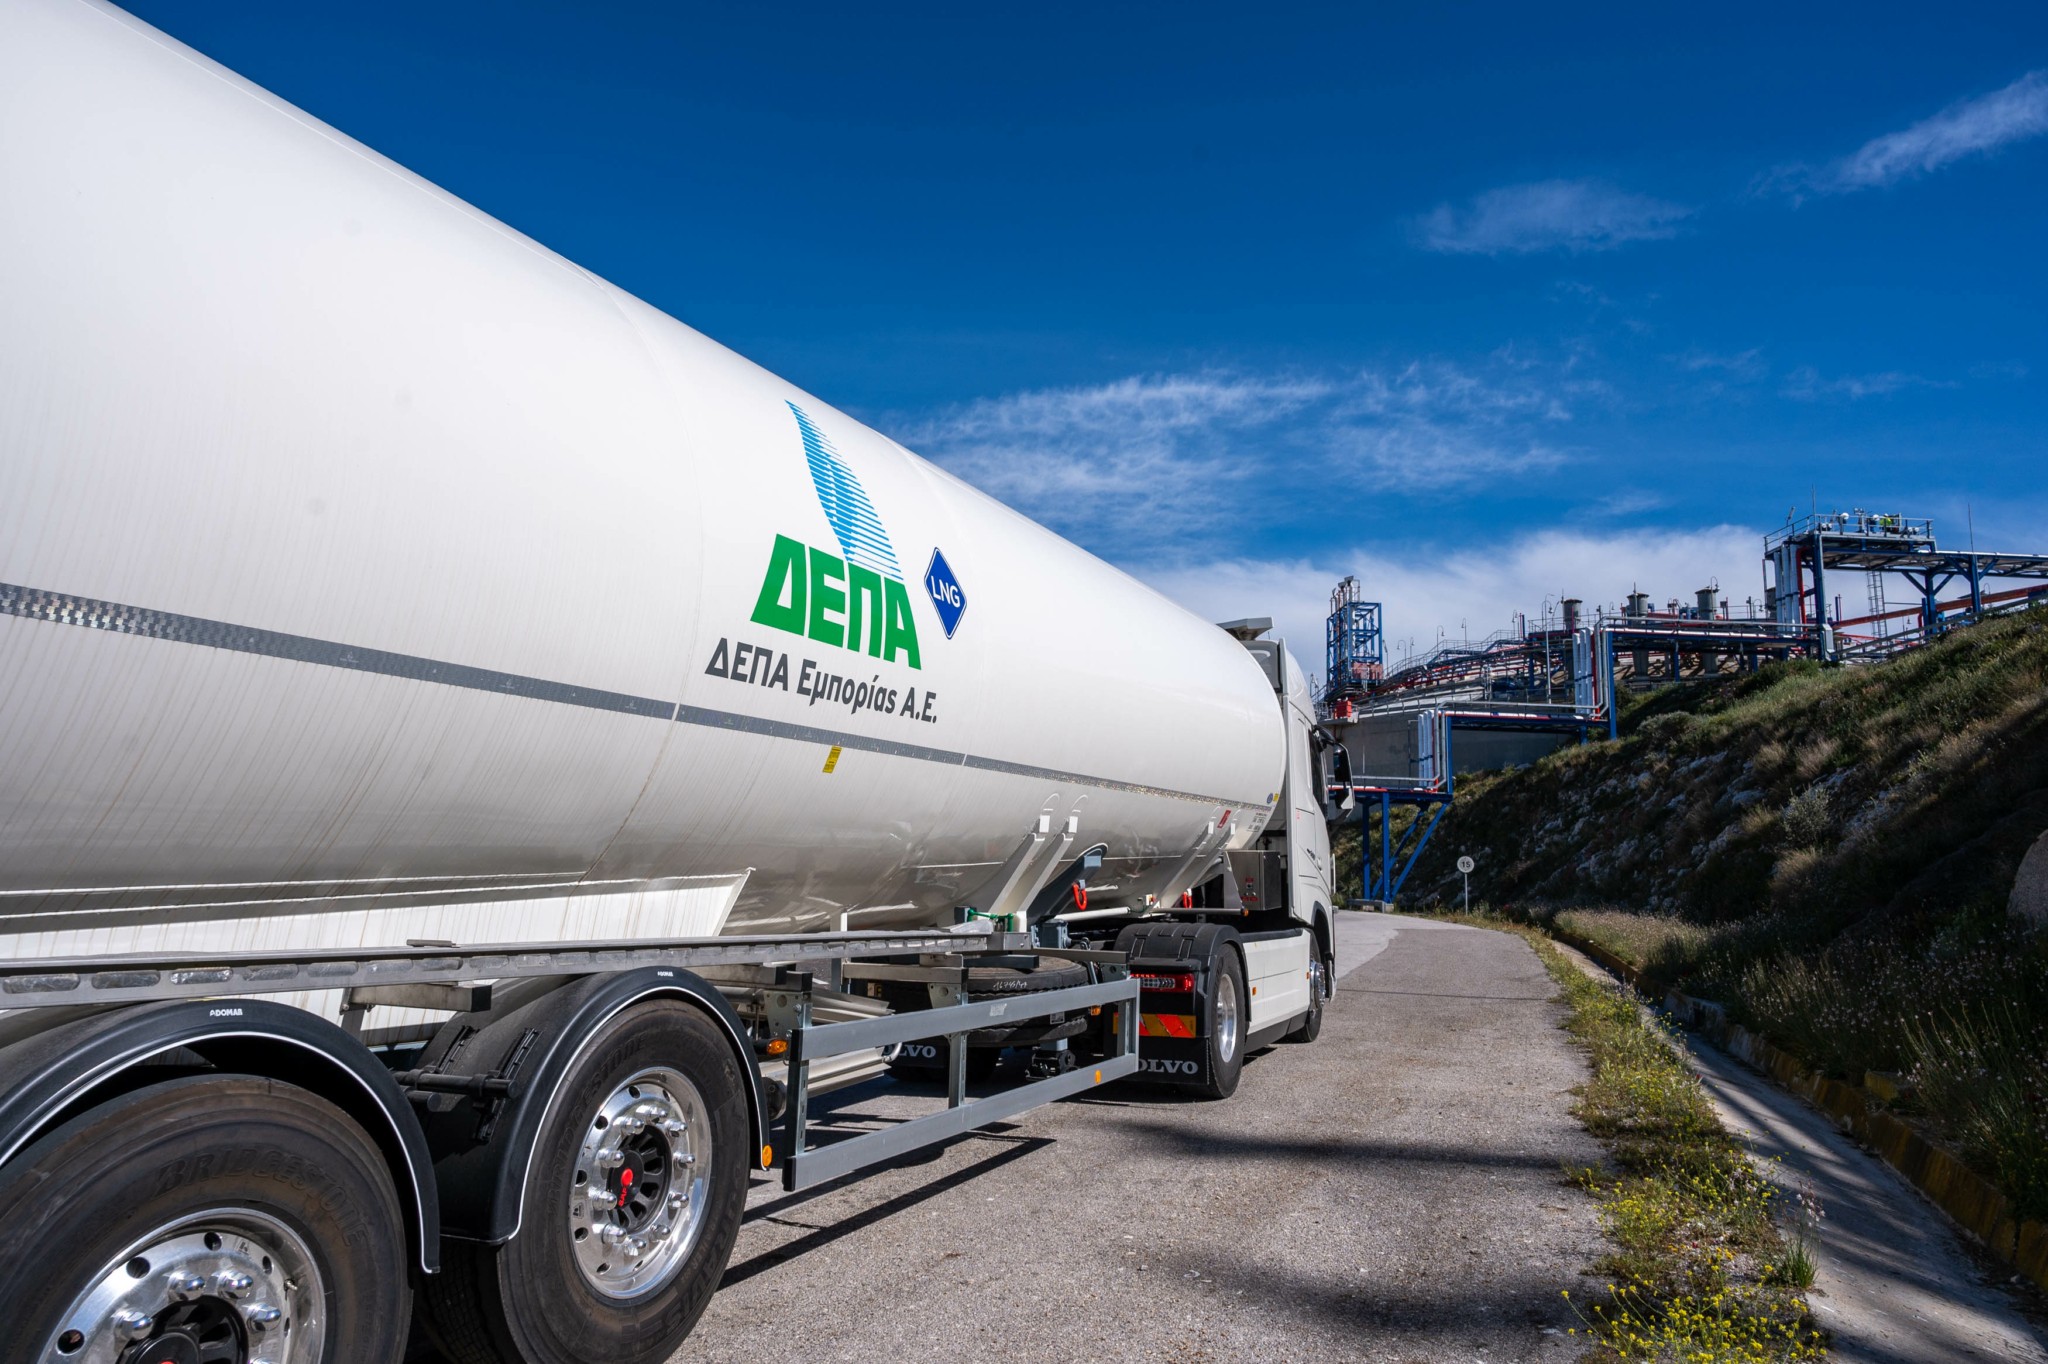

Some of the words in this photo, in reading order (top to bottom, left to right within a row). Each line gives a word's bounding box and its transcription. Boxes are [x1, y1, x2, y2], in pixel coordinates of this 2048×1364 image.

[750, 533, 922, 671] ΔΕΠΑ
[930, 575, 961, 608] LNG
[704, 637, 789, 692] ΔΕΠΑ
[797, 658, 898, 715] Εμπορίας
[899, 686, 938, 724] Α.Ε.
[1138, 1058, 1199, 1075] OLVO
[152, 1147, 370, 1247] BRIDGESTONE
